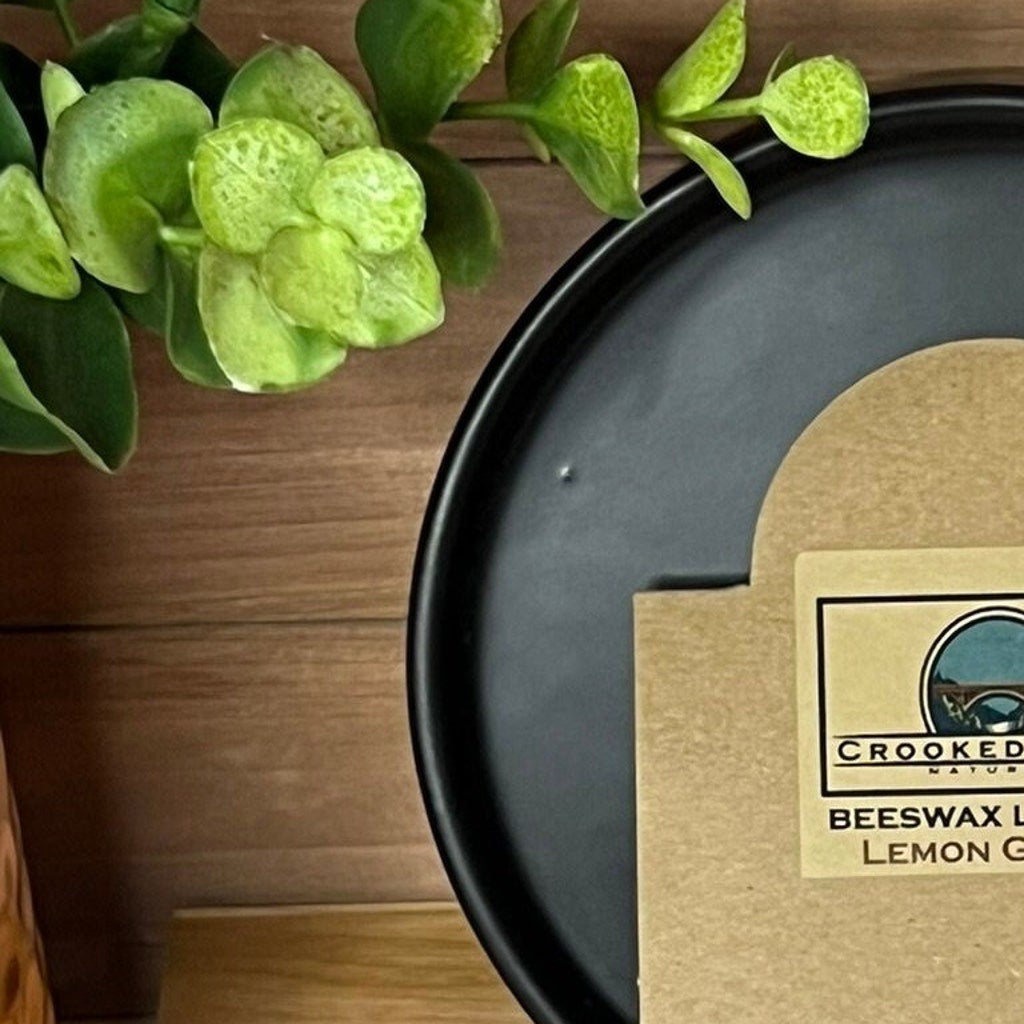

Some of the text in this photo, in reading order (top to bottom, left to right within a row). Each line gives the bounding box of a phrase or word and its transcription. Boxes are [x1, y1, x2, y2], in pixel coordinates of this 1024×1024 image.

[838, 738, 1024, 761] CROOKED
[828, 806, 1003, 830] BEESWAX
[862, 838, 990, 865] LEMON
